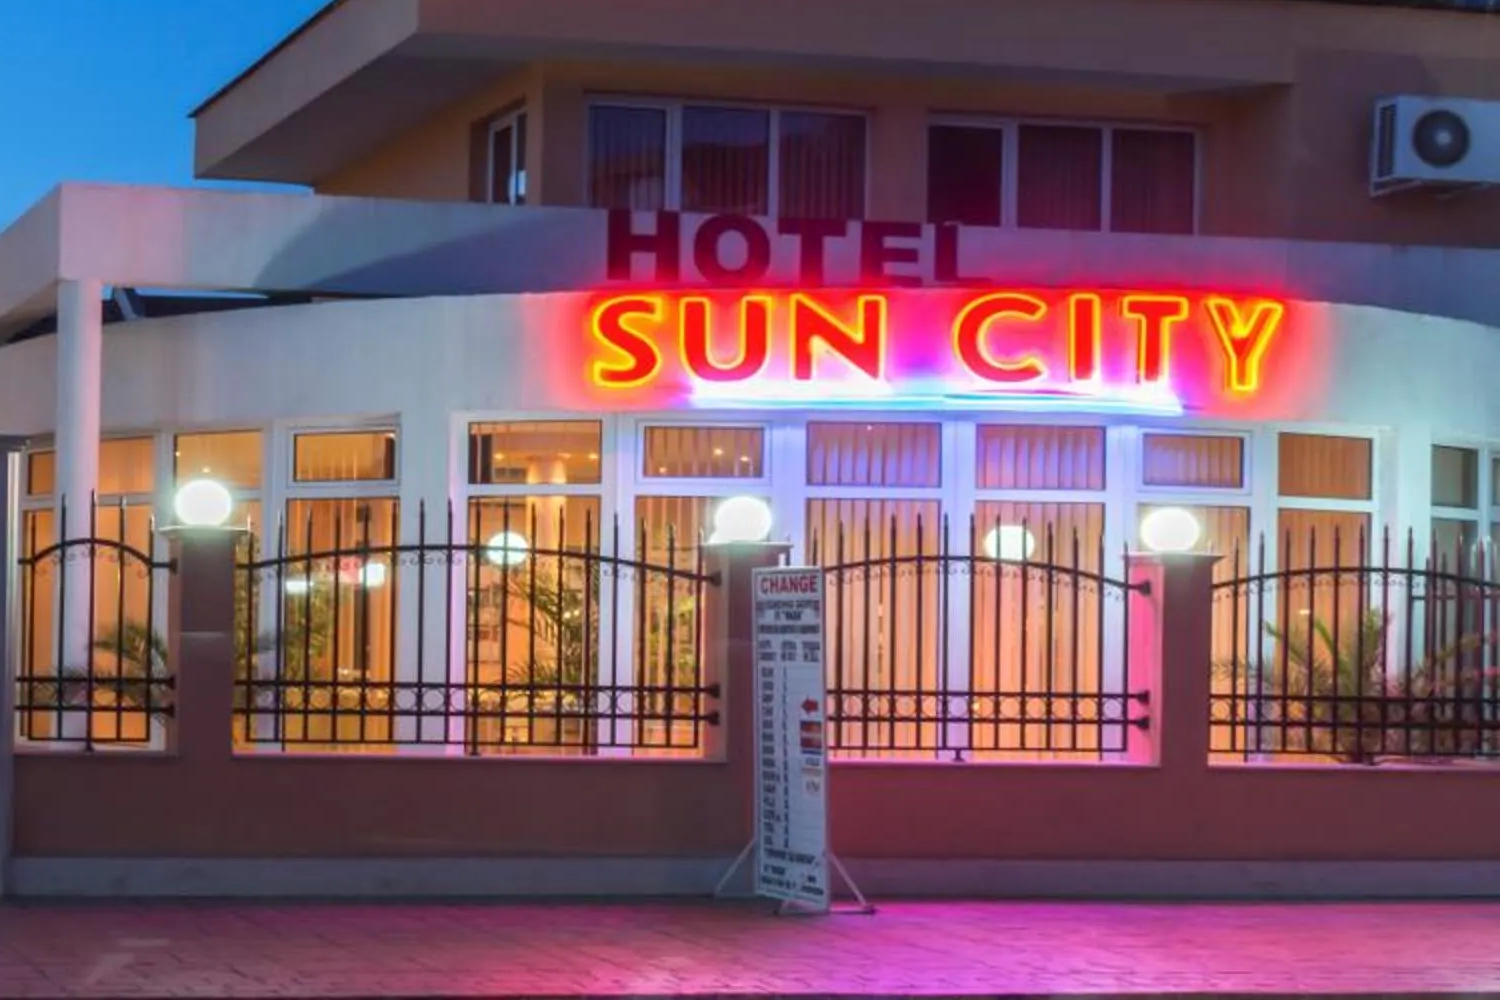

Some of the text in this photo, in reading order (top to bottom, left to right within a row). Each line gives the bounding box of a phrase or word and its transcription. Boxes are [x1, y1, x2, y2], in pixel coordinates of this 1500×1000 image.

[606, 208, 992, 288] HOTEL
[592, 292, 1284, 393] SUN CITY
[760, 574, 818, 595] CHANGE
